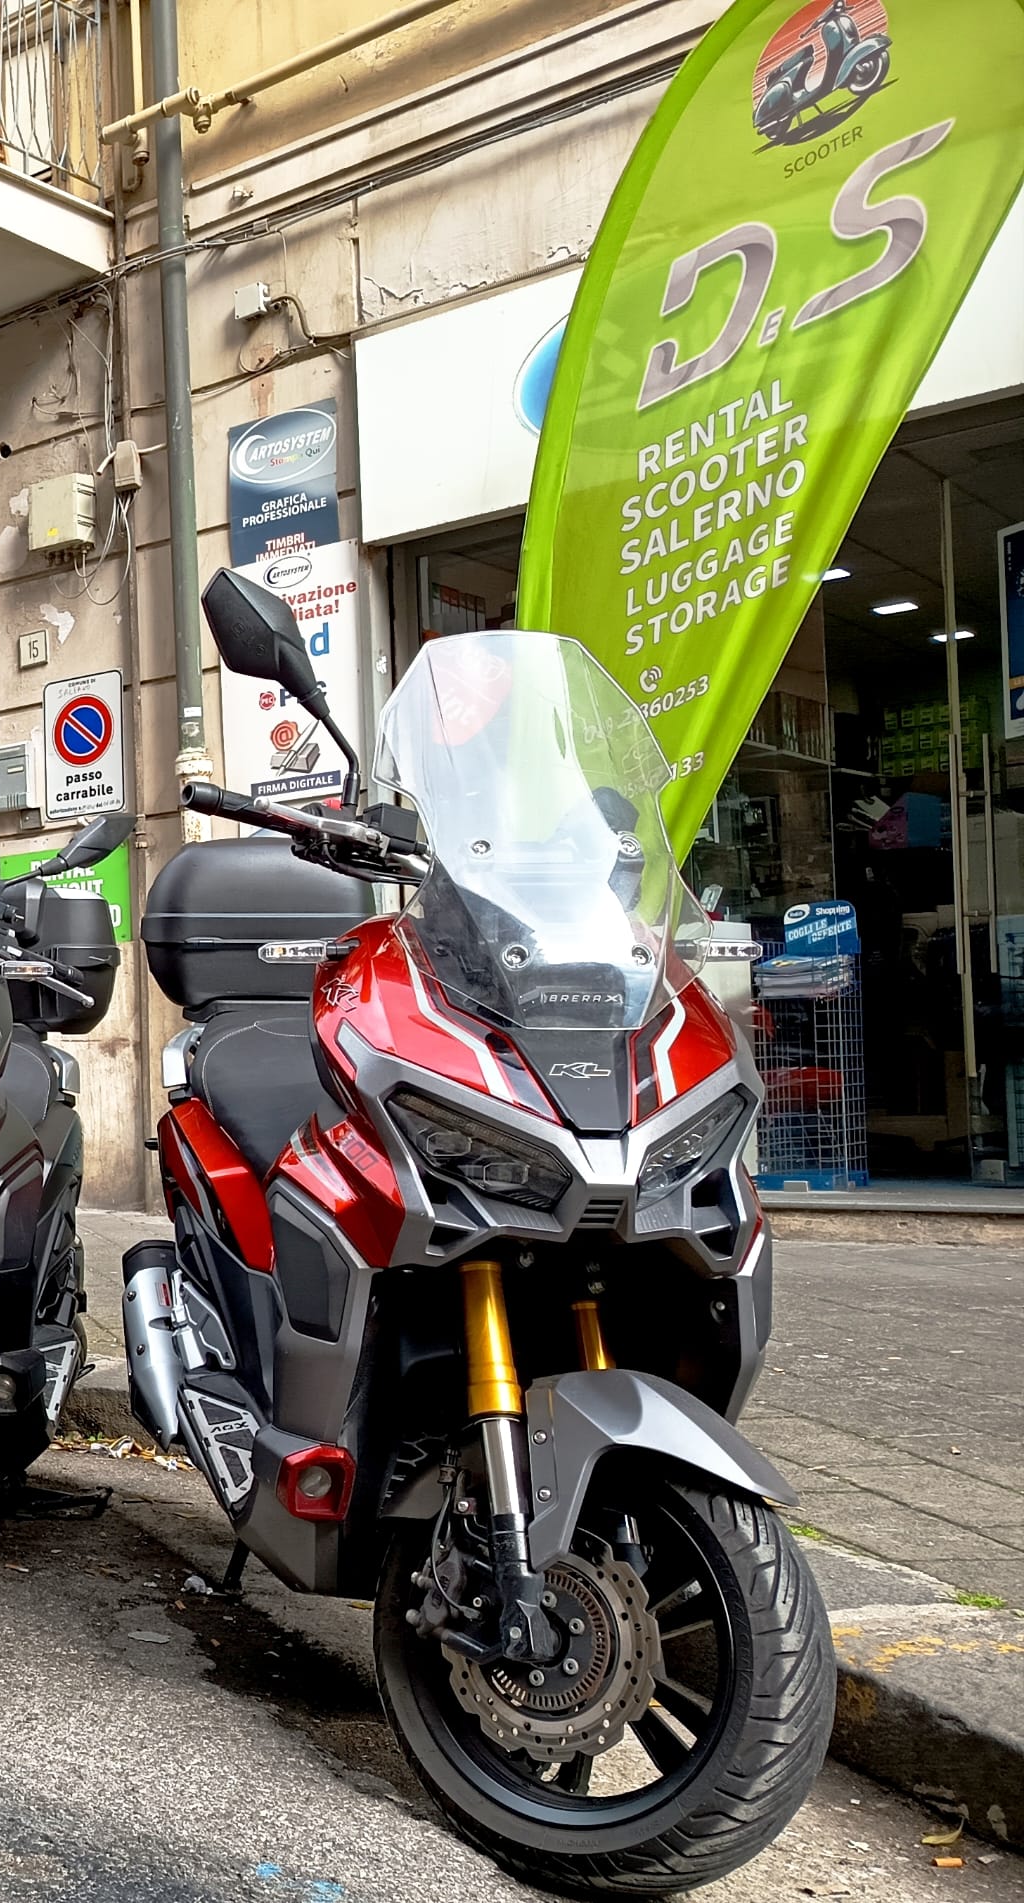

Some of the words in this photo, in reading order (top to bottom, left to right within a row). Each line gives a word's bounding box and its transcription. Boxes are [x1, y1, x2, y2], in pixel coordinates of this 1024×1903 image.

[783, 126, 864, 179] SCOOTER
[637, 379, 793, 483] RENTAL
[236, 425, 332, 475] CARTOSYSTEM
[305, 446, 320, 457] Qui
[620, 413, 809, 533] SCOOTER
[242, 497, 327, 528] PROFESSIONALE
[262, 493, 307, 512] GRAFICA
[619, 458, 807, 575] SALERNO
[266, 532, 305, 551] TIMBRI
[626, 511, 795, 618] LUGGAGE
[281, 581, 357, 606] ivazione
[624, 555, 791, 657] STORAGE
[28, 640, 39, 659] 15
[66, 770, 102, 786] passo
[670, 751, 704, 781] 133
[56, 784, 113, 802] carrabile
[257, 780, 287, 795] FIRMA
[289, 775, 334, 789] DIGITALE
[816, 905, 850, 916] Shopping
[788, 922, 813, 941] COGLI
[815, 917, 828, 931] LE
[549, 994, 602, 1003] BRERA
[604, 994, 619, 1003] X
[549, 1062, 611, 1079] KL
